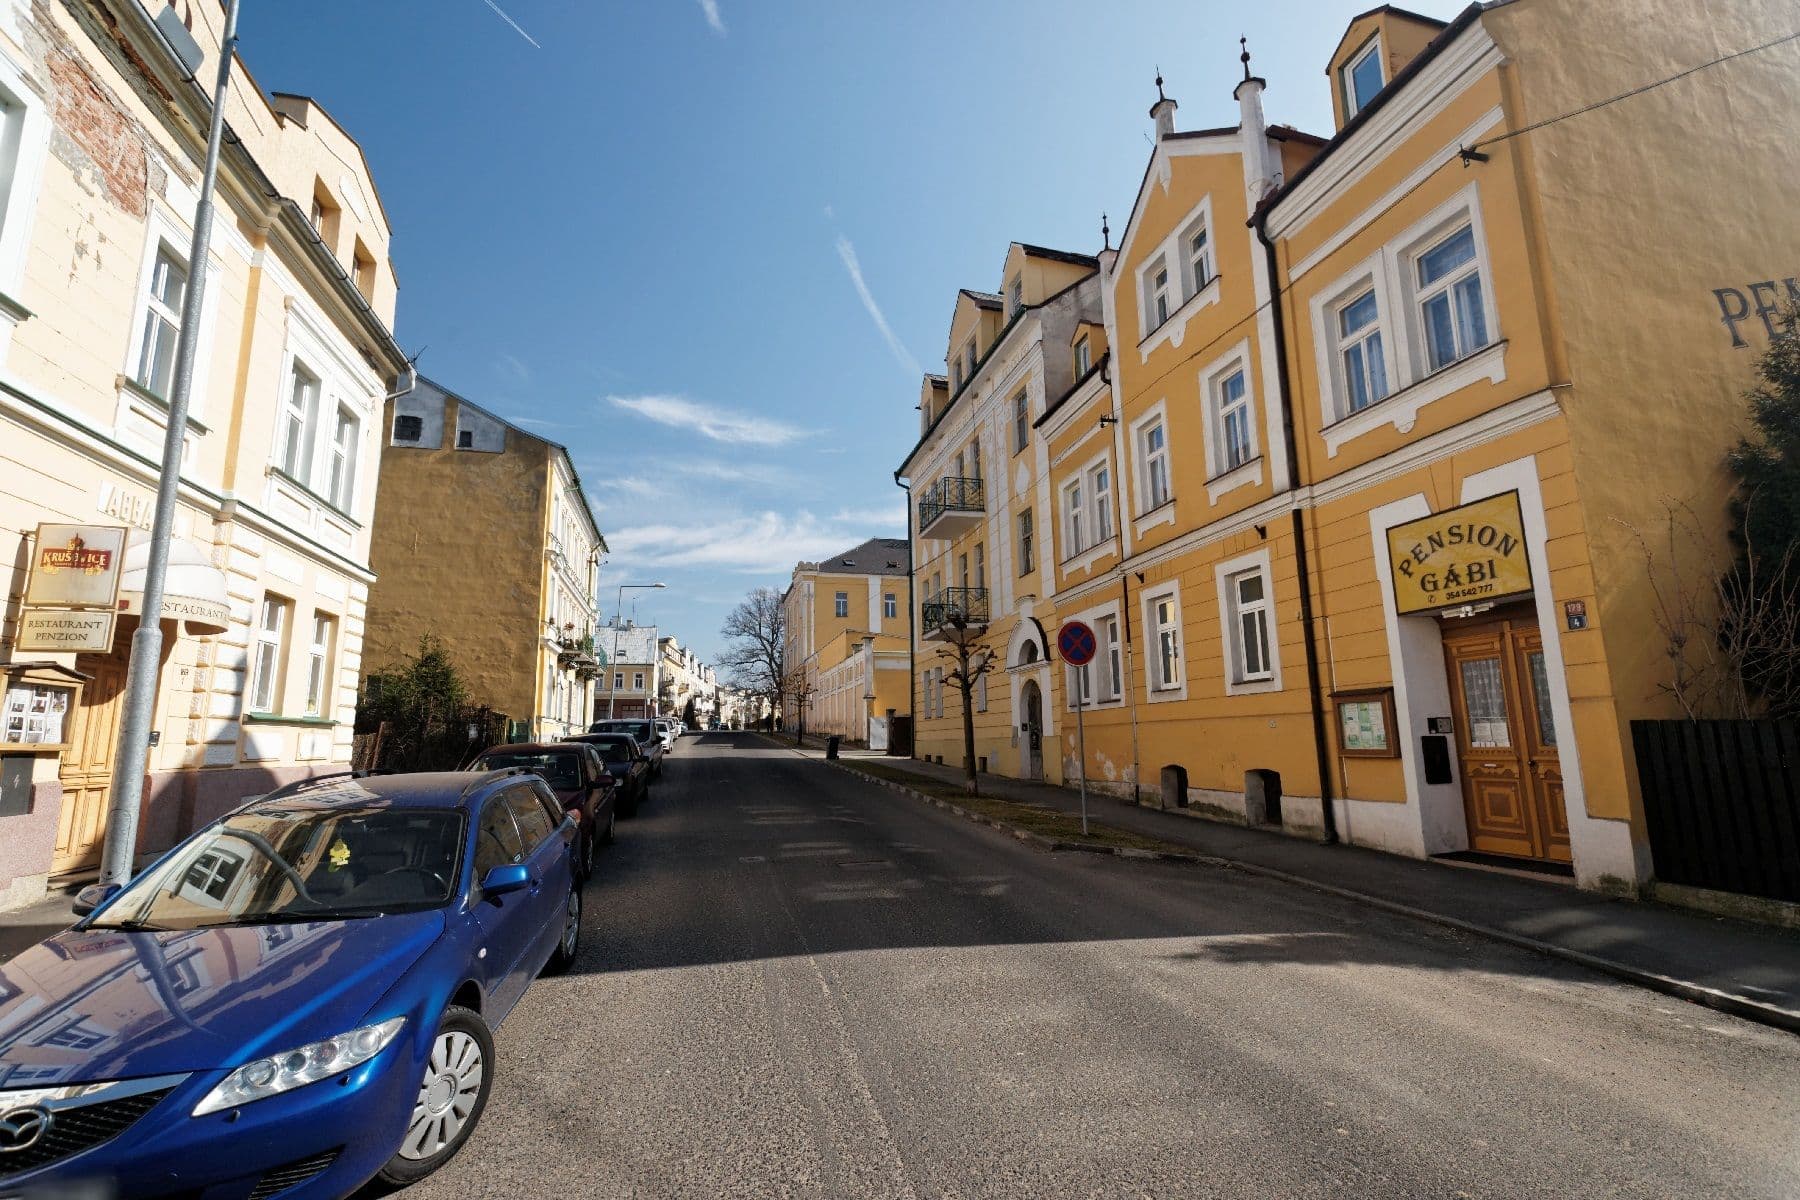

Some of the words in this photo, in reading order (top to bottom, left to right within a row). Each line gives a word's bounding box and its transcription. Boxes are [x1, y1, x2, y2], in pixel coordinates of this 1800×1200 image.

[1398, 524, 1519, 578] PENSION
[1420, 559, 1499, 593] GÁBI
[1478, 584, 1493, 593] 777
[160, 602, 224, 618] ESTAURANT
[28, 620, 103, 629] RESTAURANT
[35, 632, 88, 641] PENZION
